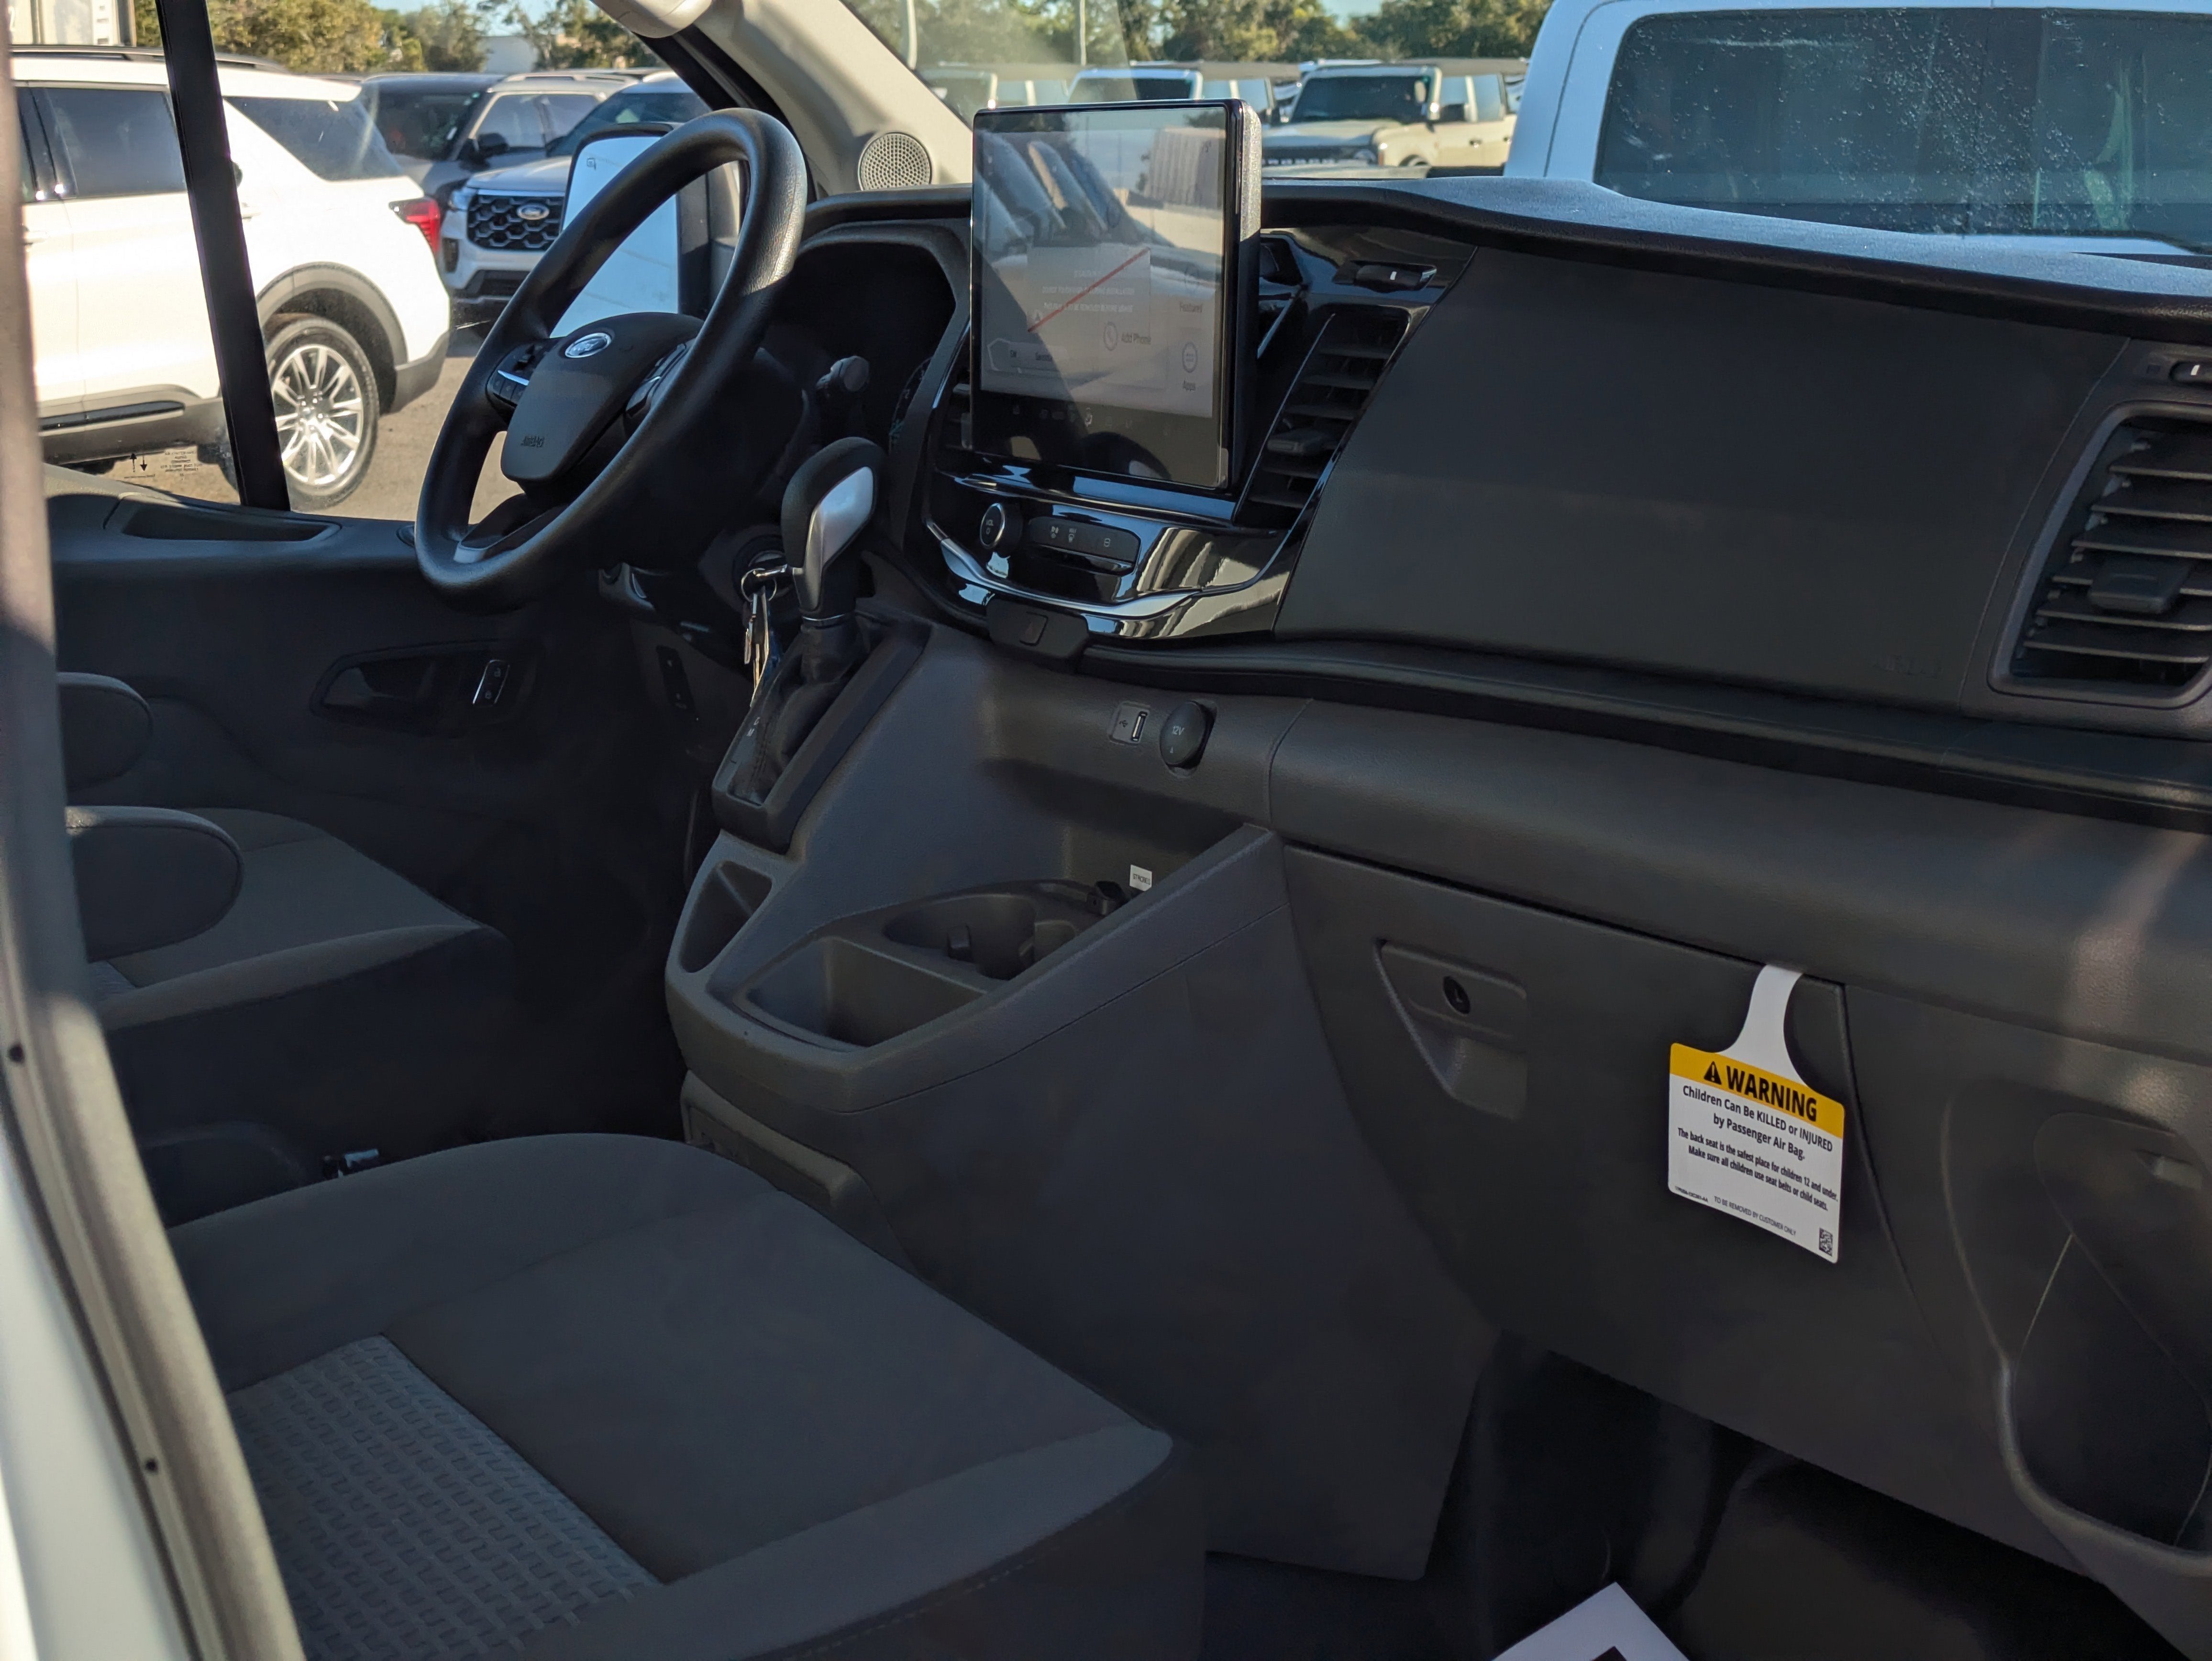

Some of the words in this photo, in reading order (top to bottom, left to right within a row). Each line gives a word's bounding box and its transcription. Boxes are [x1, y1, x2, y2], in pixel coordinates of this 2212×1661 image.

[1172, 726, 1185, 735] 12V
[1683, 1085, 1722, 1107] Children
[1724, 1099, 1741, 1114] Can
[1744, 1105, 1755, 1119] Be
[1757, 1110, 1786, 1130] KILLED
[1788, 1125, 1798, 1136] or
[1799, 1127, 1833, 1152] INJURED
[1726, 1065, 1817, 1122] WARNING
[1678, 1127, 1689, 1139] The
[1690, 1130, 1704, 1144] back
[1705, 1138, 1718, 1149] seat
[1719, 1141, 1725, 1151] is
[1725, 1143, 1736, 1155] the
[1737, 1149, 1754, 1163] safest
[1755, 1155, 1770, 1169] place
[1771, 1161, 1780, 1173] for
[1781, 1166, 1803, 1183] children
[1804, 1176, 1810, 1187] 12
[1811, 1181, 1821, 1193] and
[1822, 1187, 1838, 1202] under.
[1714, 1113, 1725, 1129] by
[1727, 1118, 1771, 1144] Passenger
[1773, 1136, 1786, 1150] Air
[1788, 1142, 1805, 1161] Bag.
[1688, 1144, 1706, 1159] Make
[1706, 1152, 1720, 1163] sure
[1730, 1160, 1753, 1176] children
[1754, 1171, 1764, 1181] use
[1765, 1175, 1777, 1187] seat
[1778, 1178, 1792, 1193] belts
[1792, 1187, 1799, 1196] or
[1800, 1189, 1813, 1203] child
[1814, 1197, 1828, 1211] seats.
[1714, 1196, 1721, 1204] TO
[1722, 1198, 1728, 1207] BE
[1729, 1201, 1751, 1216] REMOVED
[1759, 1214, 1783, 1230] CUSTOMER
[1784, 1225, 1796, 1236] ONLY
